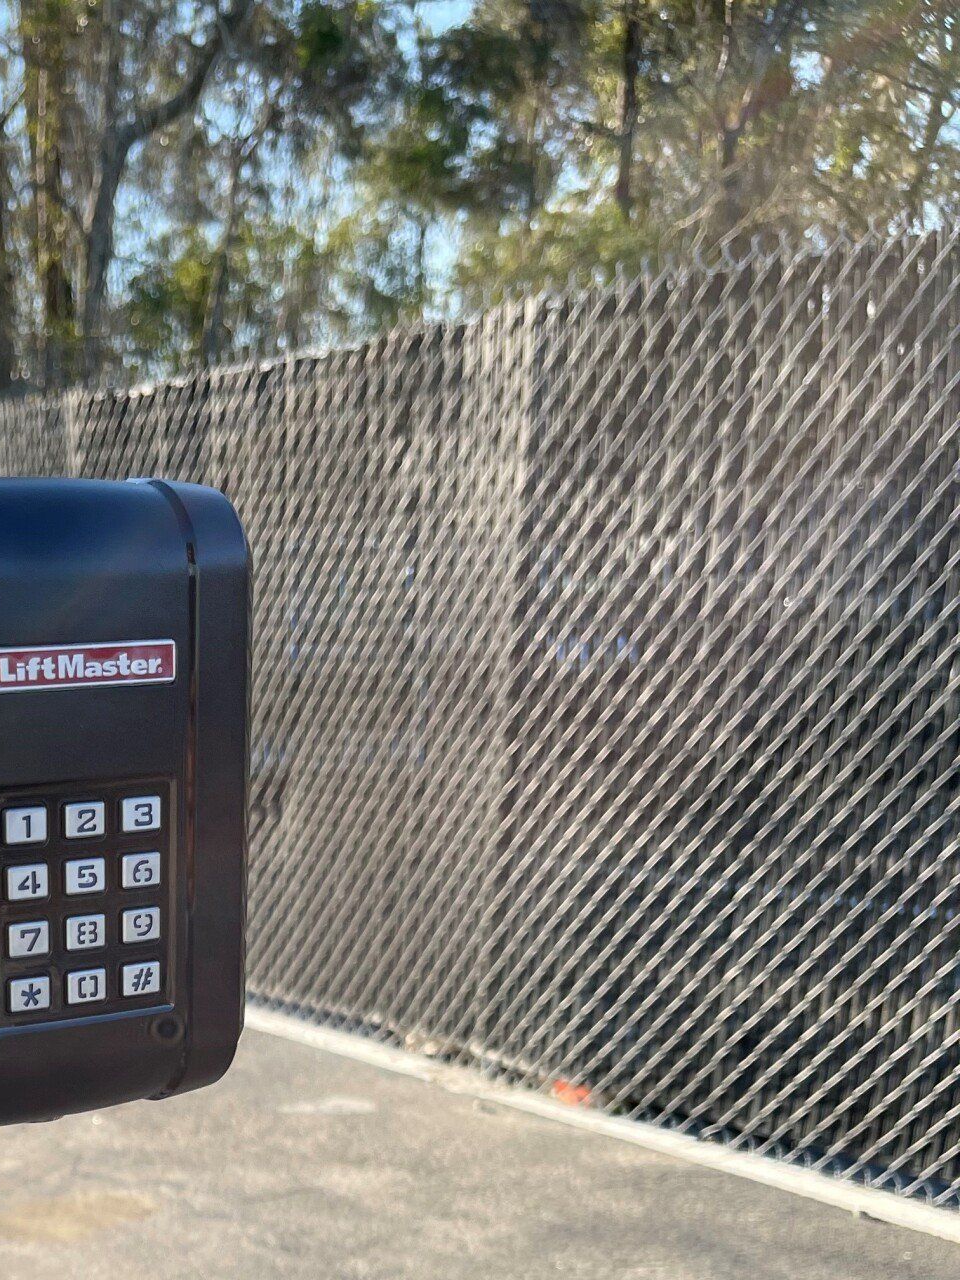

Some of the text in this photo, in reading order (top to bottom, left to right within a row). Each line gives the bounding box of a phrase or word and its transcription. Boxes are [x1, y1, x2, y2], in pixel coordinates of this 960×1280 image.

[21, 802, 153, 839] 1 2 3
[17, 859, 153, 895] 4 5 6
[20, 913, 153, 952] 7 8 9
[77, 975, 99, 999] 0
[132, 967, 153, 992] #
